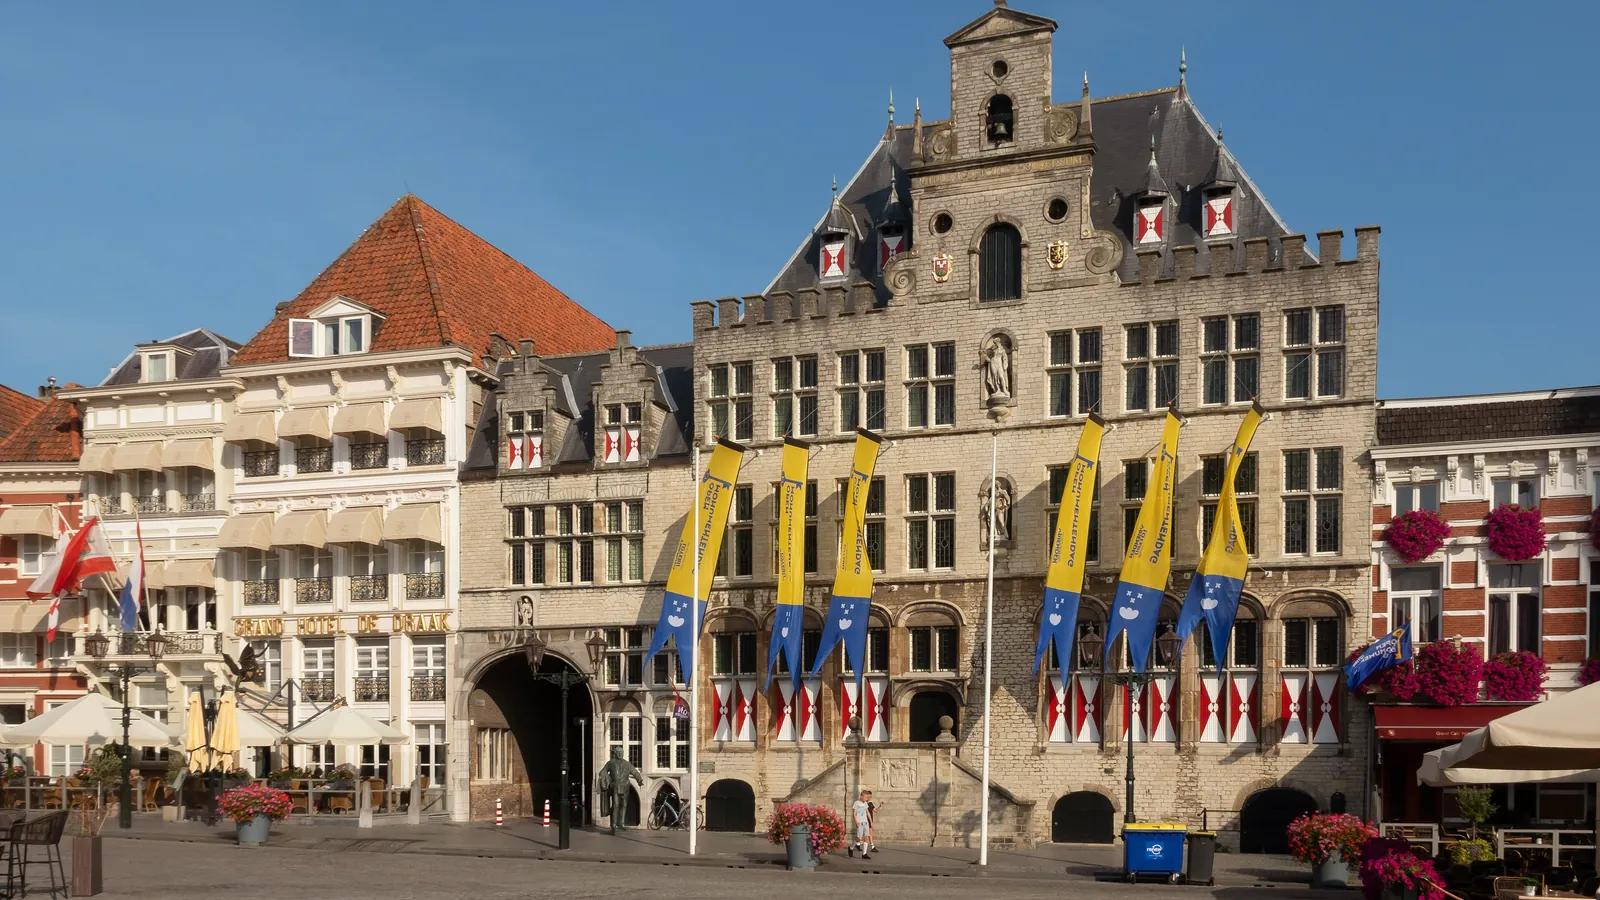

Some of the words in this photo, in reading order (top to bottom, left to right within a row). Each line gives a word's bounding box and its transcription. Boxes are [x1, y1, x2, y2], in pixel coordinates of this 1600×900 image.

[234, 617, 285, 636] GRAND
[297, 615, 345, 635] HOTEL
[358, 614, 379, 633] DE
[393, 612, 451, 632] DRAAK
